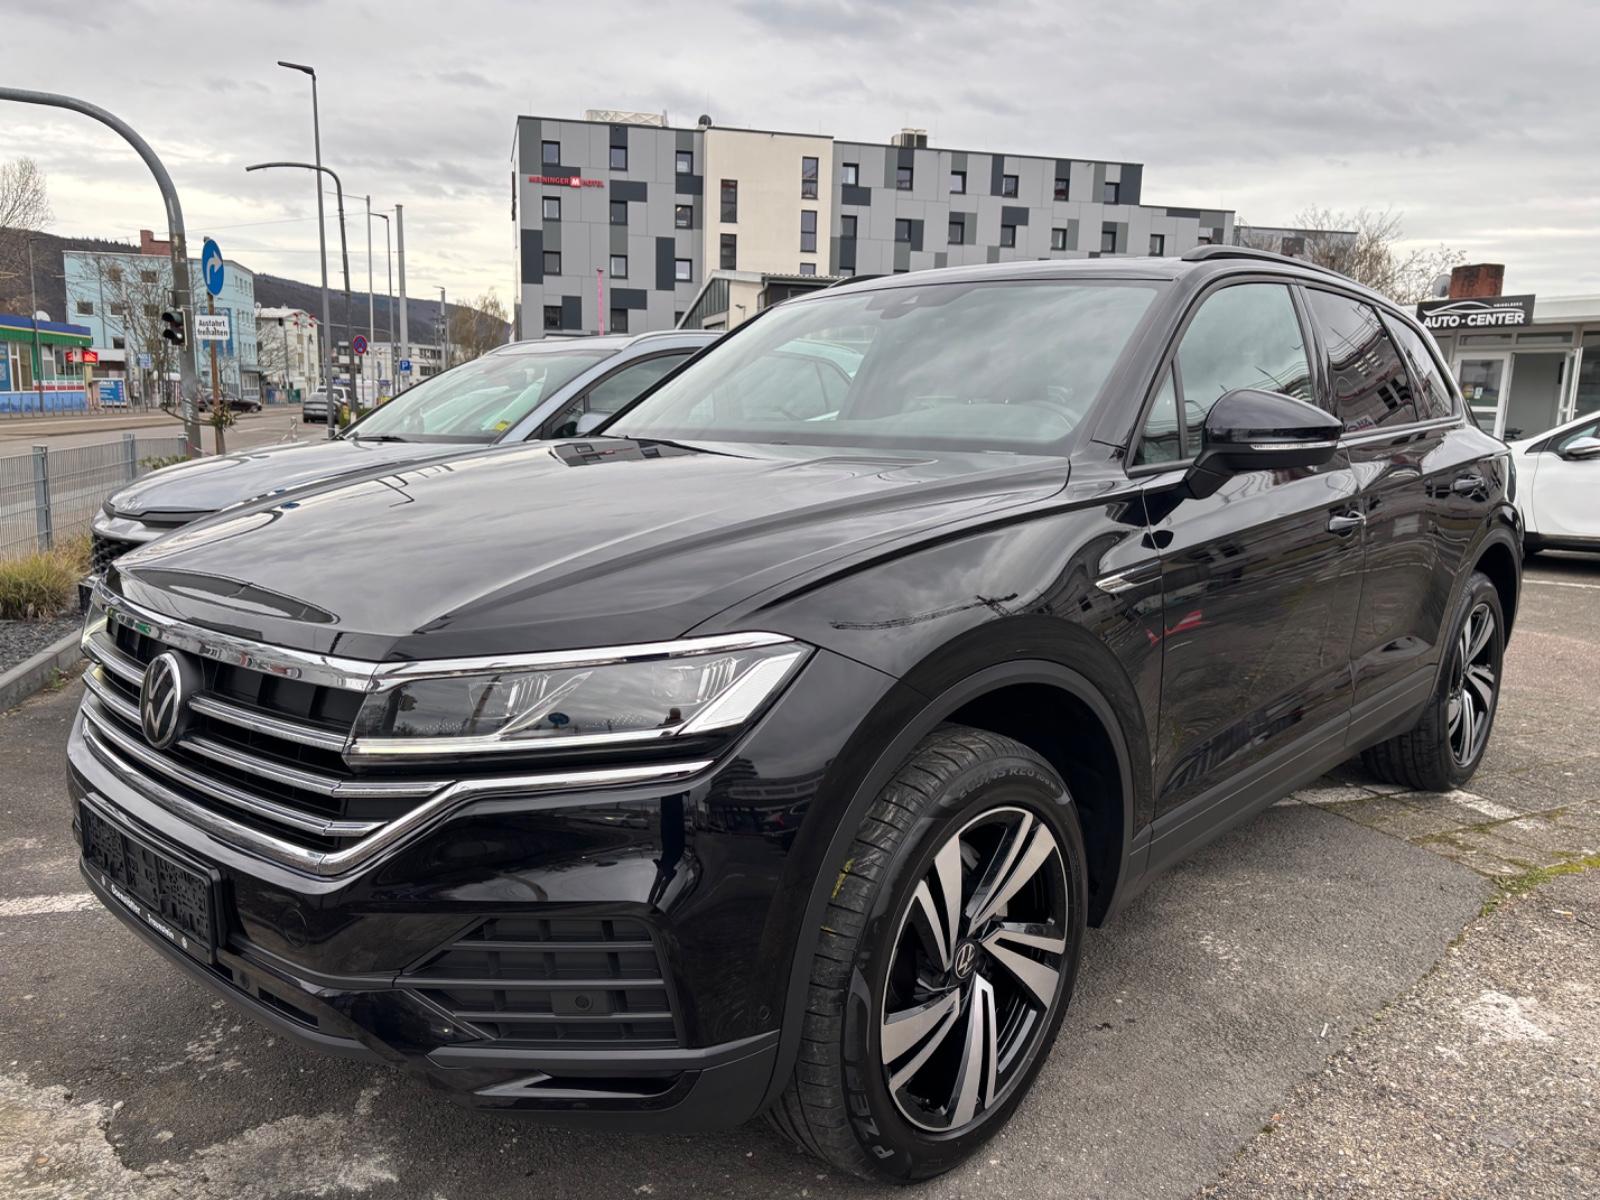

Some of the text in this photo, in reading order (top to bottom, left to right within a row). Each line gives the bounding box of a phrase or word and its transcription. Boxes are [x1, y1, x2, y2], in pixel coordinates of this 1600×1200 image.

[199, 319, 225, 327] Ausfahrt
[1467, 313, 1525, 326] CENTER
[197, 326, 228, 337] freihalten
